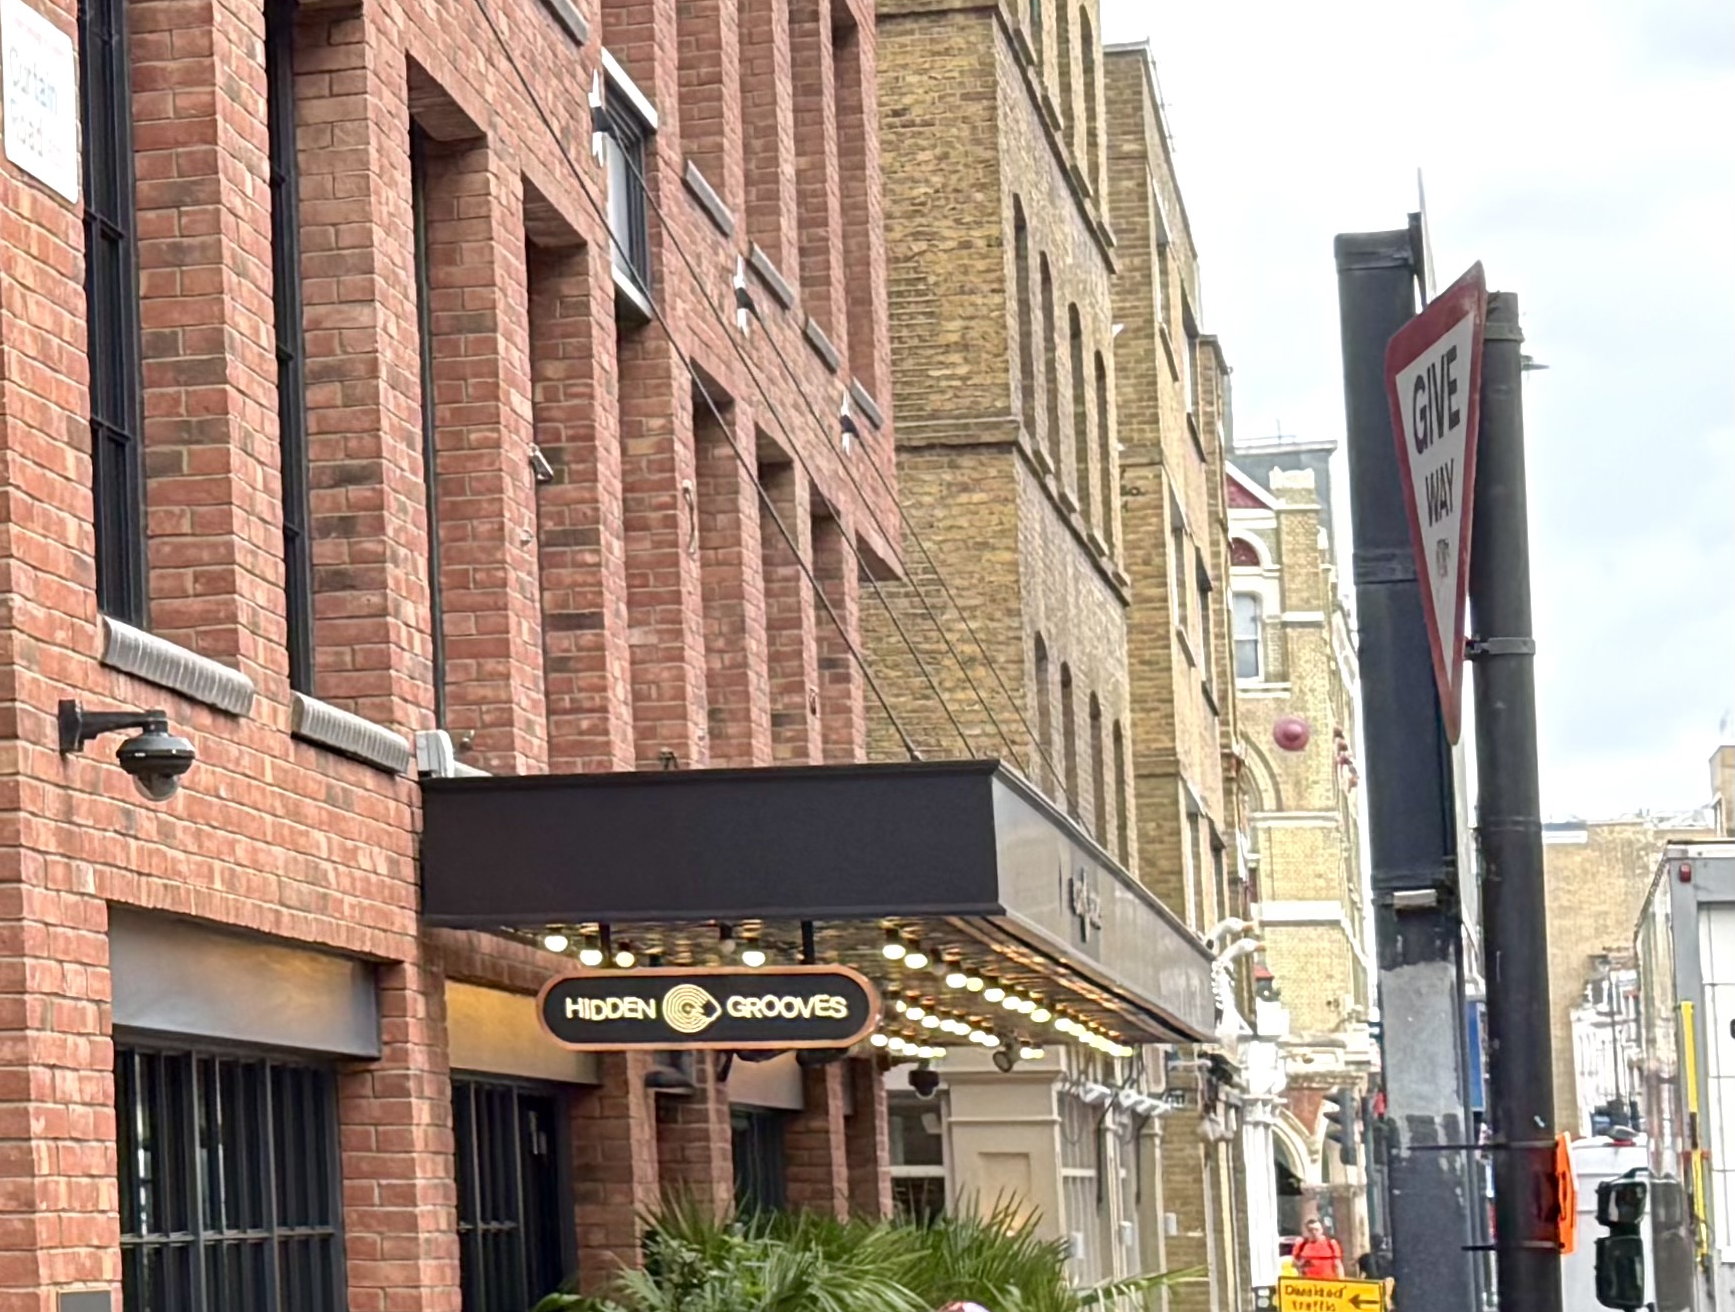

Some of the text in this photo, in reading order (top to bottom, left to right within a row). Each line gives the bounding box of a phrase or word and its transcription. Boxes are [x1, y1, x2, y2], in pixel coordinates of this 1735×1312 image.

[1411, 344, 1460, 457] GIVE
[1424, 457, 1455, 529] WAY
[565, 993, 849, 1021] HIDDEN GROOVES
